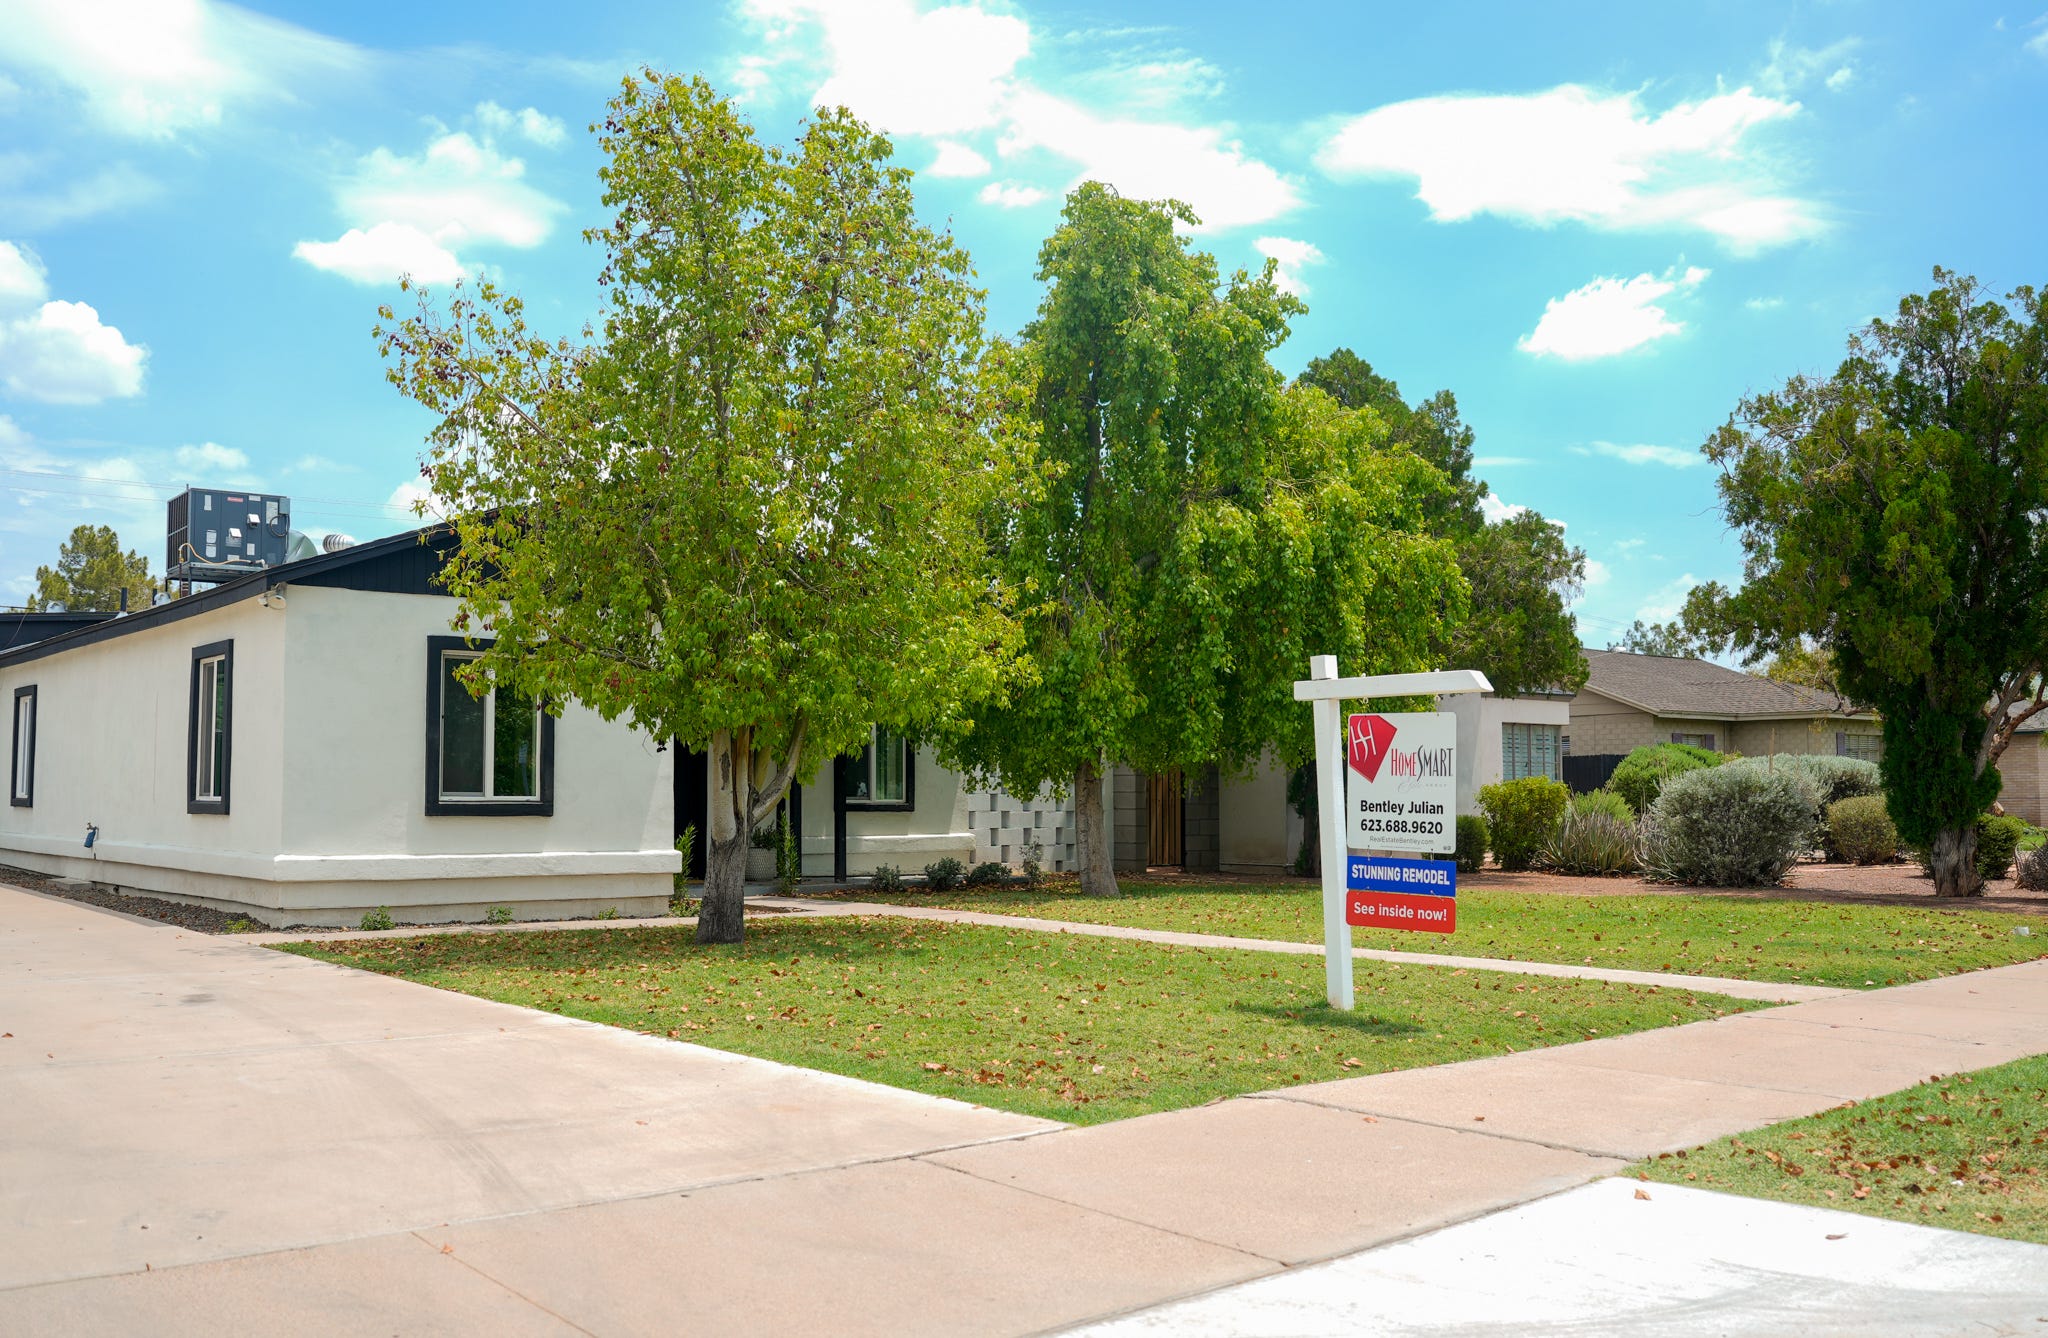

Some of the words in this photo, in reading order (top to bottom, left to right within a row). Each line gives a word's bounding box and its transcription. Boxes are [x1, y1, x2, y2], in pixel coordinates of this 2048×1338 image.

[1360, 800, 1405, 815] Bentley
[1408, 801, 1444, 815] Julian
[1360, 819, 1443, 834] 623.688.9620
[1369, 835, 1435, 846] RealEstateBentley.com
[1352, 864, 1401, 882] STUNNING
[1402, 868, 1450, 885] REMODEL
[1354, 901, 1375, 915] See
[1378, 904, 1414, 918] inside
[1417, 909, 1447, 921] now!
